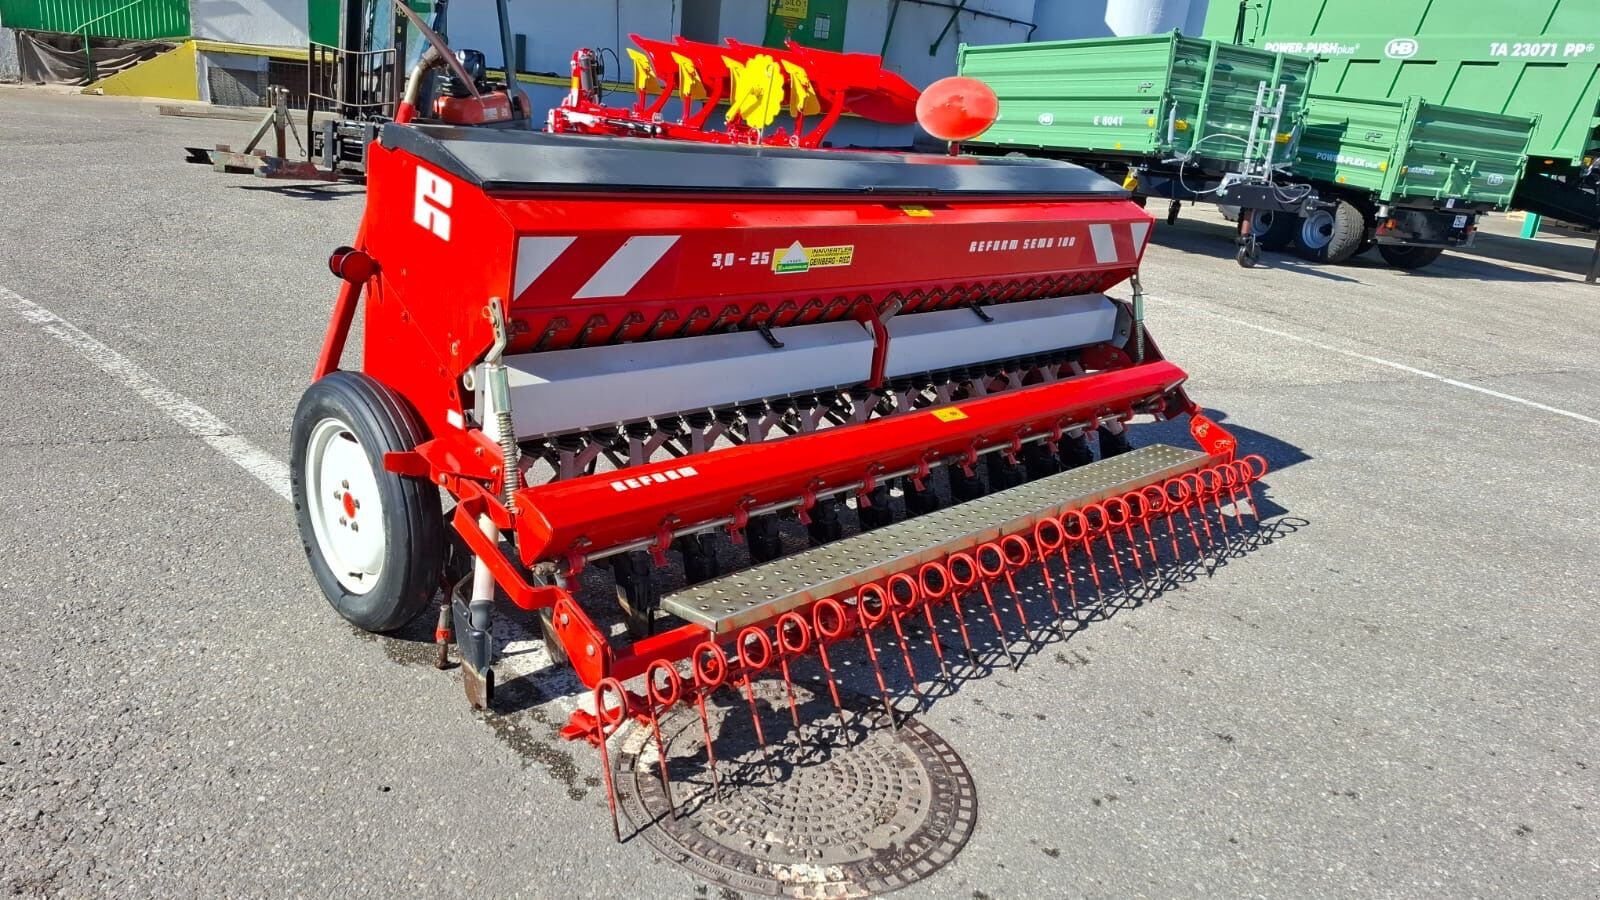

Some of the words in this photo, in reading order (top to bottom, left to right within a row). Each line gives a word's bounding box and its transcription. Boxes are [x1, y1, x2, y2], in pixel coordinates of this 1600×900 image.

[1490, 43, 1508, 56] TA
[1511, 43, 1558, 57] 23071
[1093, 115, 1100, 125] E
[969, 240, 1018, 253] REFORM
[1023, 237, 1054, 249] SEMO
[1057, 236, 1076, 247] 100
[712, 252, 735, 270] 3,0
[750, 251, 771, 265] 25
[839, 255, 851, 264] RIED
[610, 466, 699, 491] REFORM
